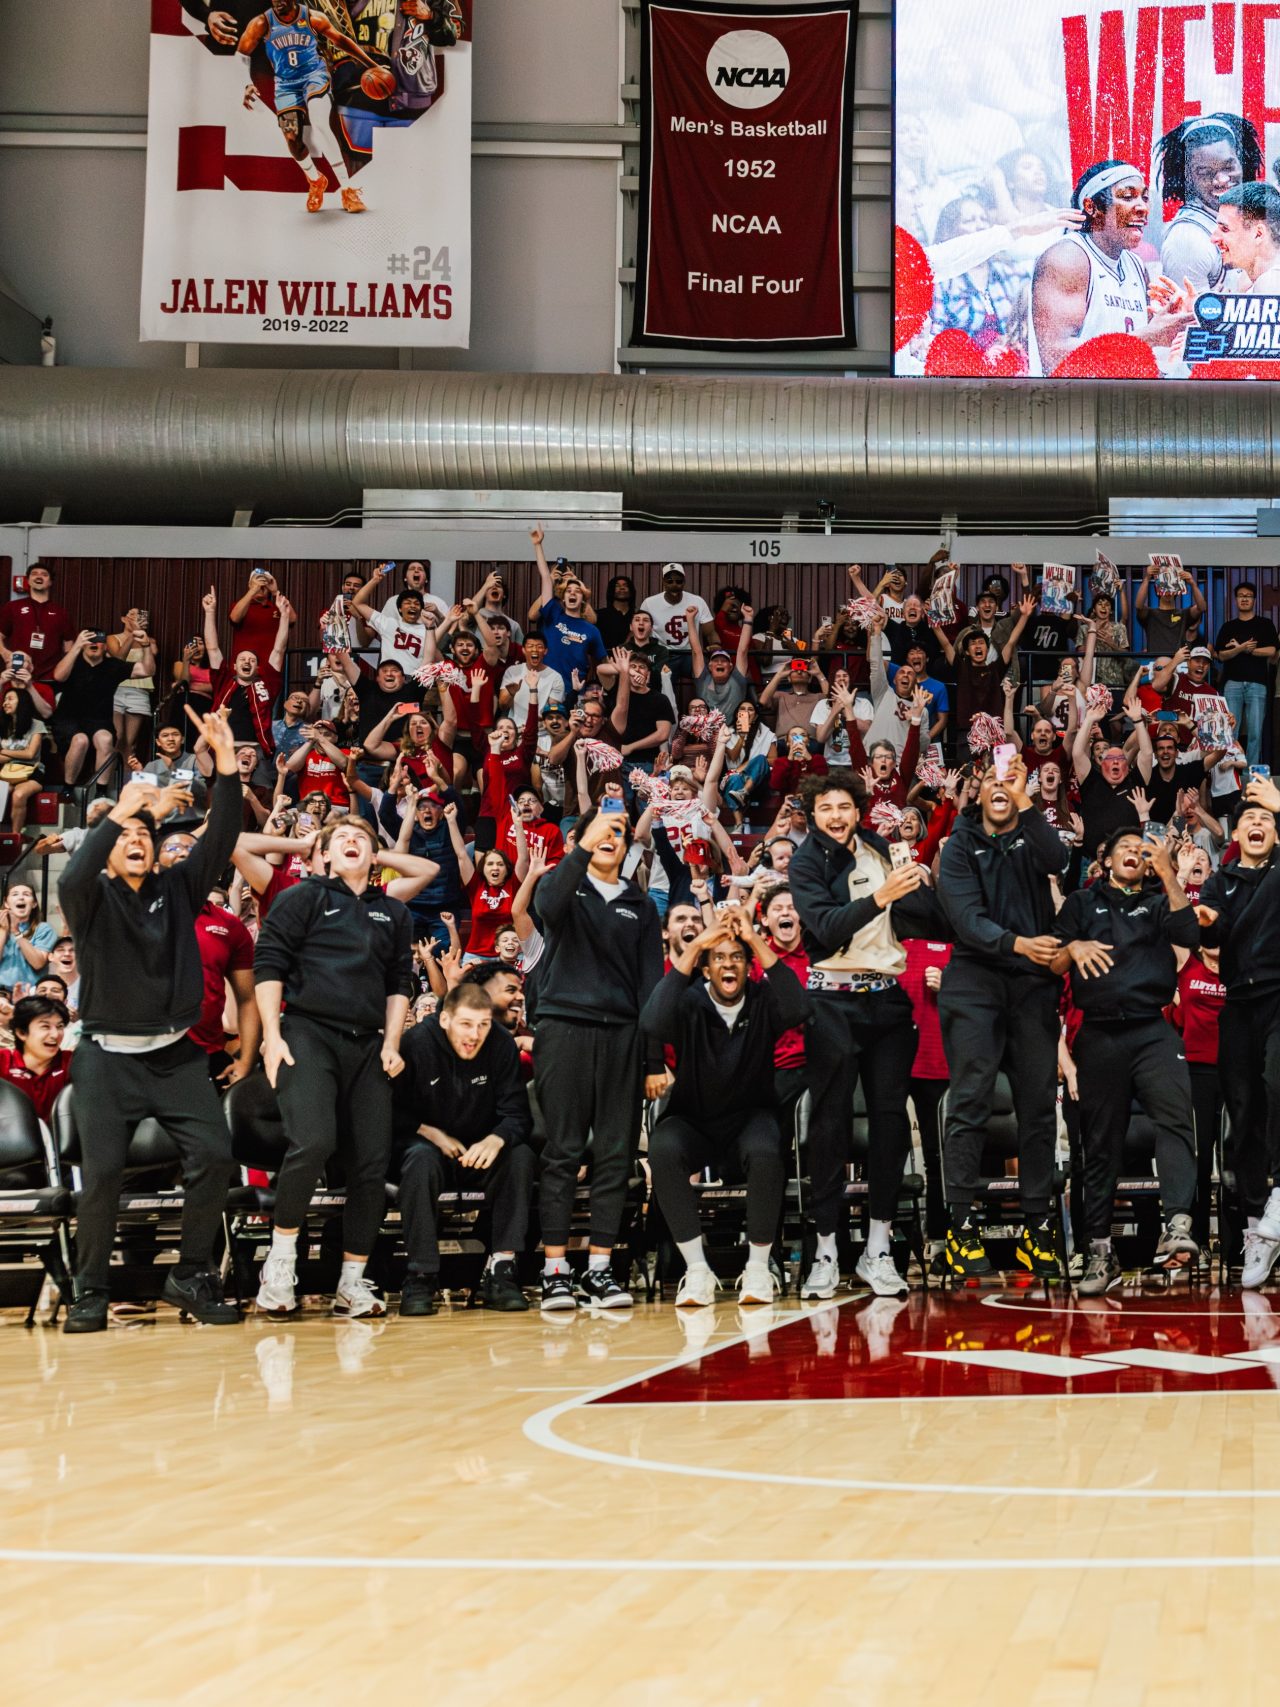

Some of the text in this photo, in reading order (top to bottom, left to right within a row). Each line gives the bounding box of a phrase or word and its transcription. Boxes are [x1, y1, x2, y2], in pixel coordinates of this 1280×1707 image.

[271, 32, 311, 50] THUNDER
[287, 50, 298, 67] 8
[715, 66, 786, 88] NCAA
[670, 116, 827, 137] Men’s Basketball
[724, 159, 776, 178] 1952
[712, 214, 782, 234] NCAA
[387, 245, 452, 281] #24
[688, 271, 804, 294] Final Four
[160, 278, 452, 319] JALEN WILLIAMS
[1200, 306, 1222, 315] NCAA
[262, 318, 349, 333] 2019-2022
[749, 540, 781, 557] 105
[861, 973, 883, 982] PSD
[1189, 979, 1217, 992] SANTA
